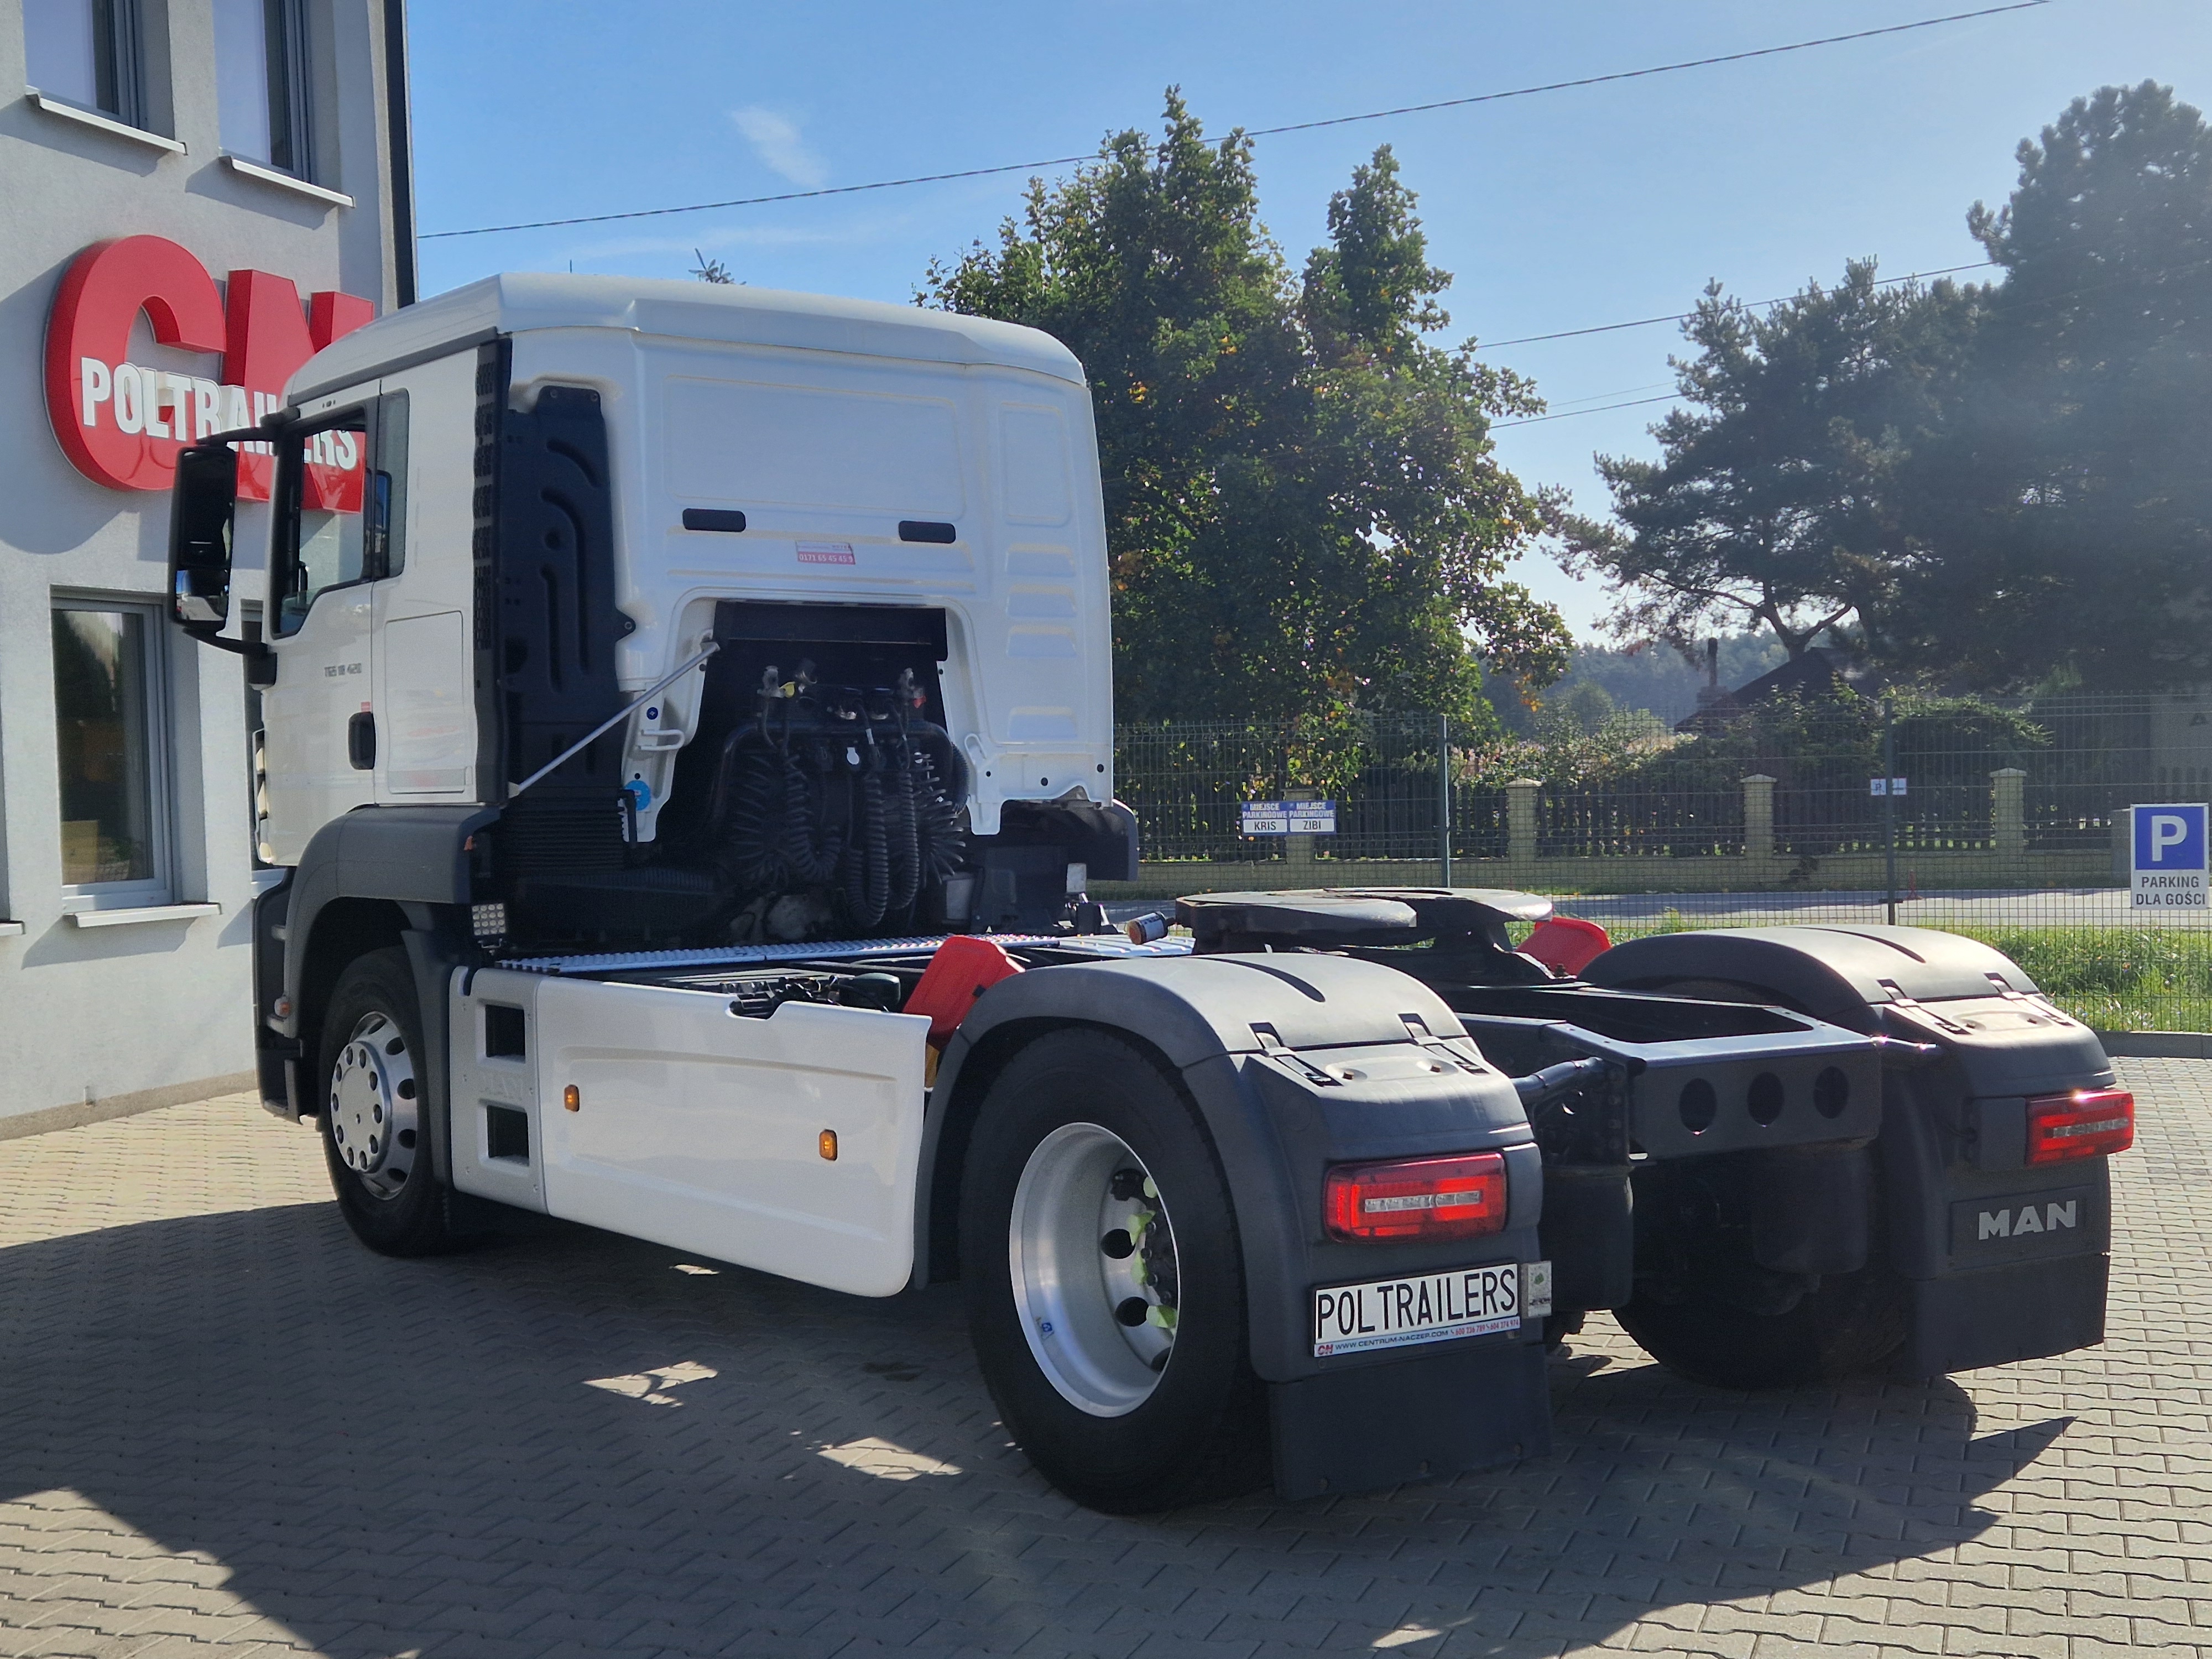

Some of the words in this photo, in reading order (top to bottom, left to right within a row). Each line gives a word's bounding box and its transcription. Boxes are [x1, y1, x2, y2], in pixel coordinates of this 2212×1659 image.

[81, 357, 357, 470] POLTRAIRS
[1288, 810, 1335, 818] PARKINGOWE
[1254, 821, 1276, 831] KRIS
[1303, 821, 1321, 830] ZIBI
[2151, 815, 2188, 862] P
[2141, 876, 2199, 888] PARKING
[2136, 893, 2161, 905] DLA
[2166, 890, 2205, 905] GOŚCI
[1979, 1200, 2076, 1240] MAN
